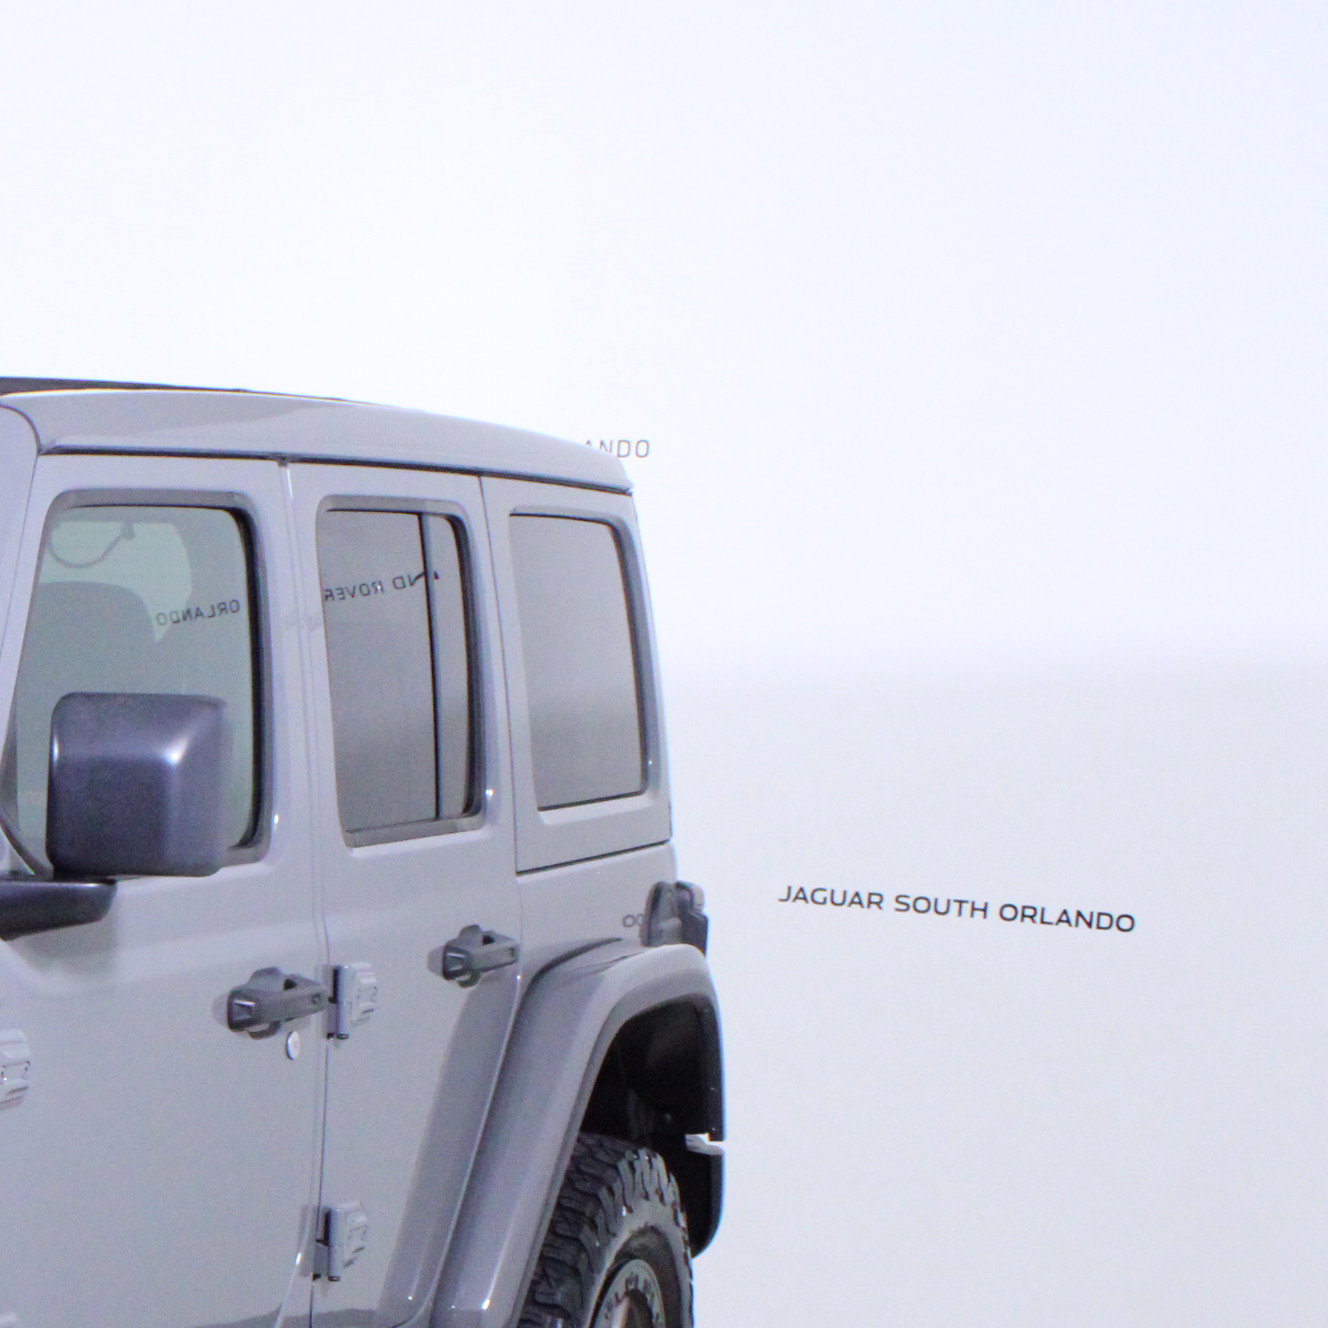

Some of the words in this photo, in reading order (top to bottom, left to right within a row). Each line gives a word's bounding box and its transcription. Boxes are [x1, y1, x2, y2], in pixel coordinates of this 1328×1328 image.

[777, 884, 885, 911] JAGUAR
[893, 893, 990, 920] SOUTH
[998, 902, 1137, 934] ORLANDO
